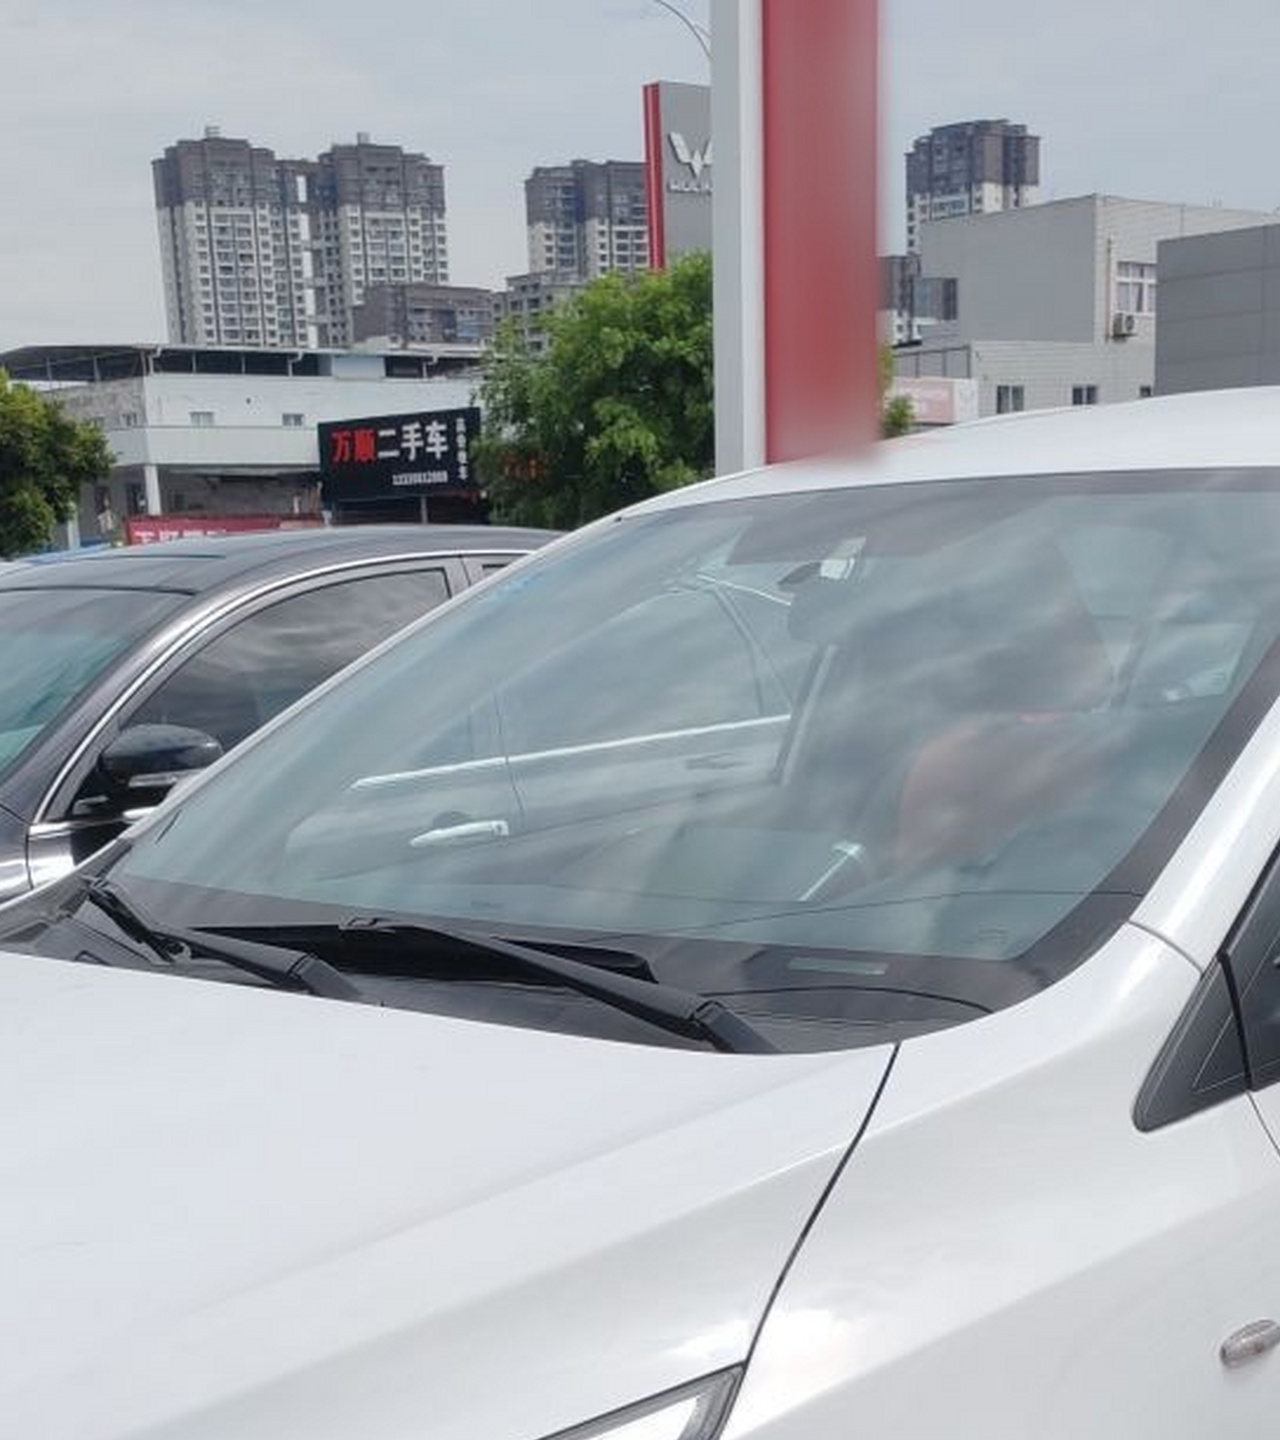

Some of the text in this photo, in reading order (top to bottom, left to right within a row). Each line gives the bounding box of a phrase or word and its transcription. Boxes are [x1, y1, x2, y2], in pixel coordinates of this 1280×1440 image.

[330, 420, 448, 463] 万顺二手车
